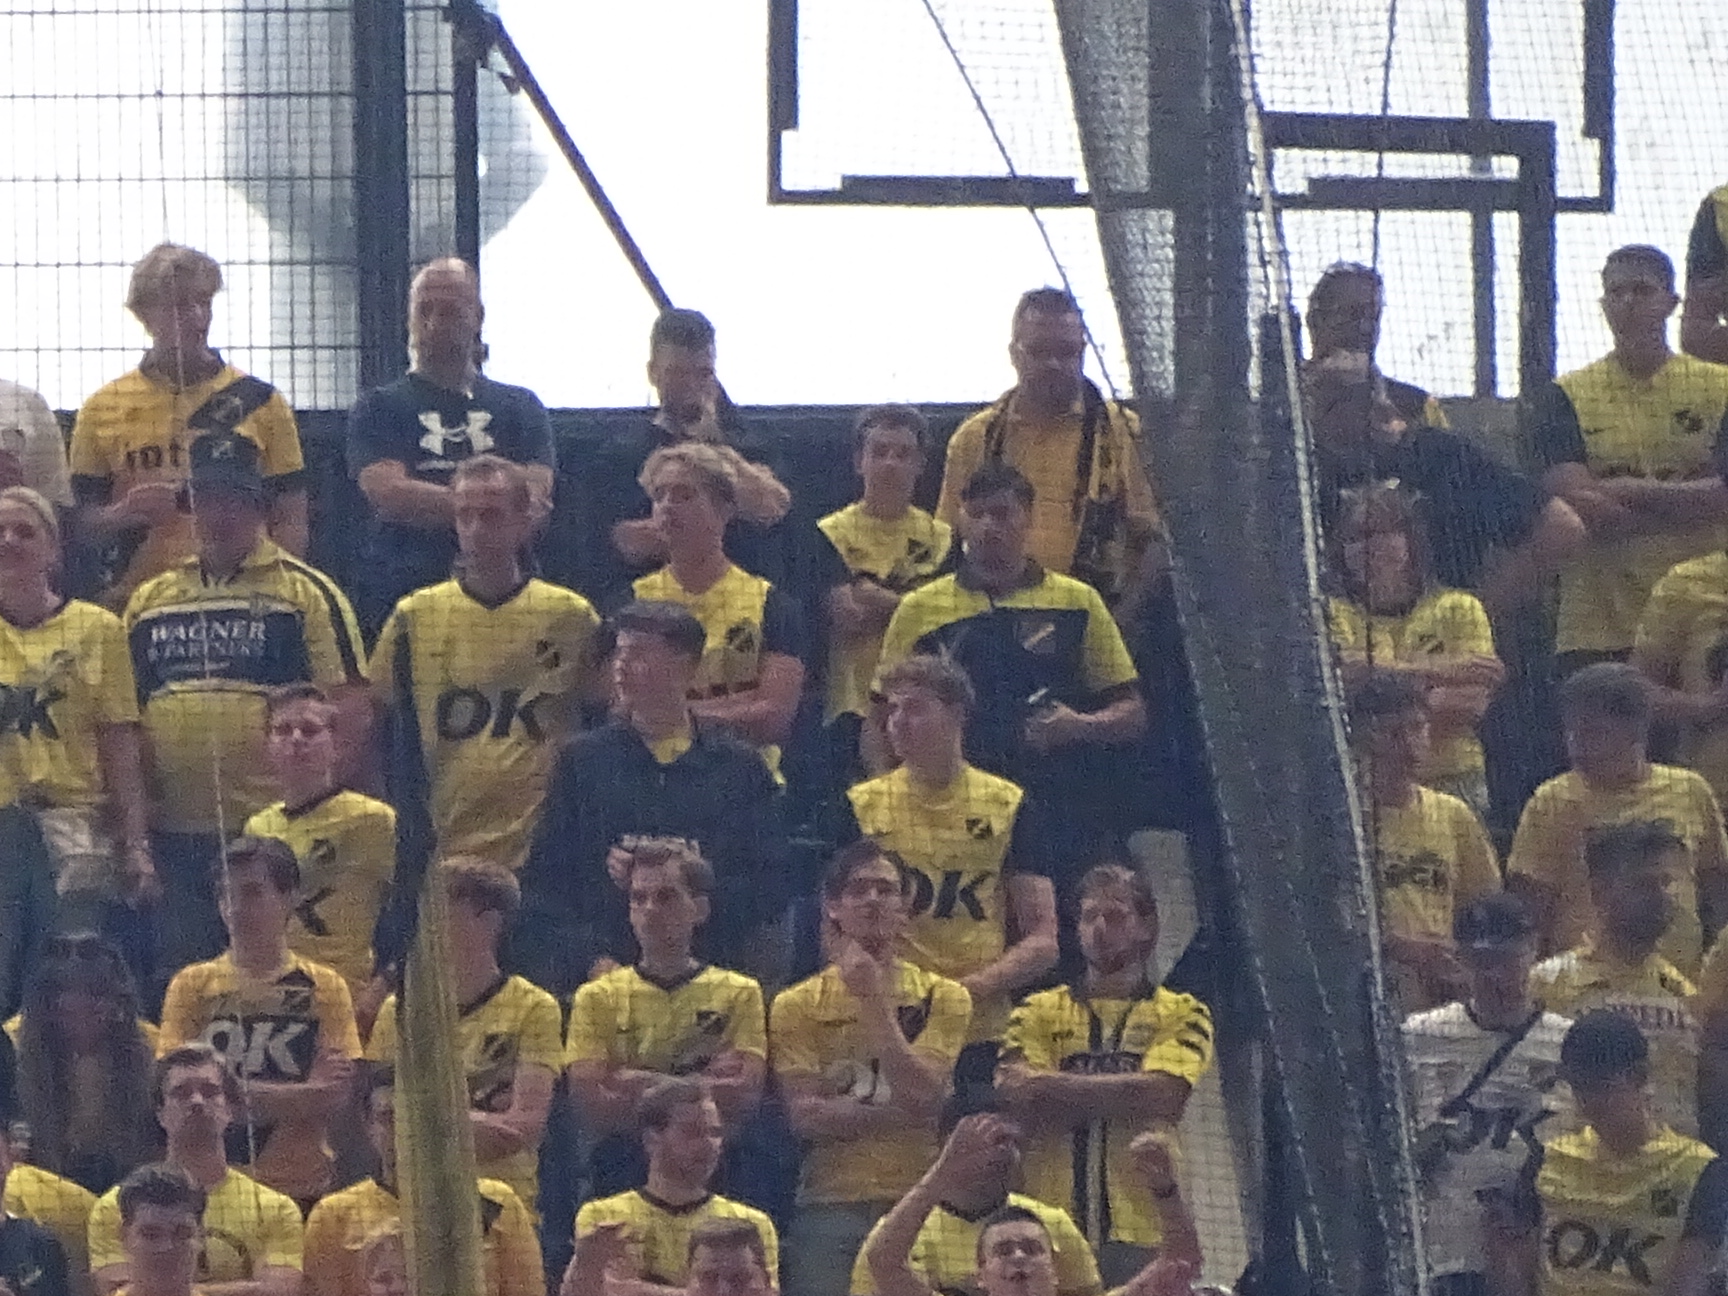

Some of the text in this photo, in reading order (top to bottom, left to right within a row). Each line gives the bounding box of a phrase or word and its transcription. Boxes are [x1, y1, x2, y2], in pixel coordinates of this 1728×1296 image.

[149, 619, 266, 643] WAGNER
[436, 686, 544, 742] OK
[900, 870, 990, 921] OK
[205, 1013, 316, 1080] OK
[1547, 1221, 1670, 1287] OK
